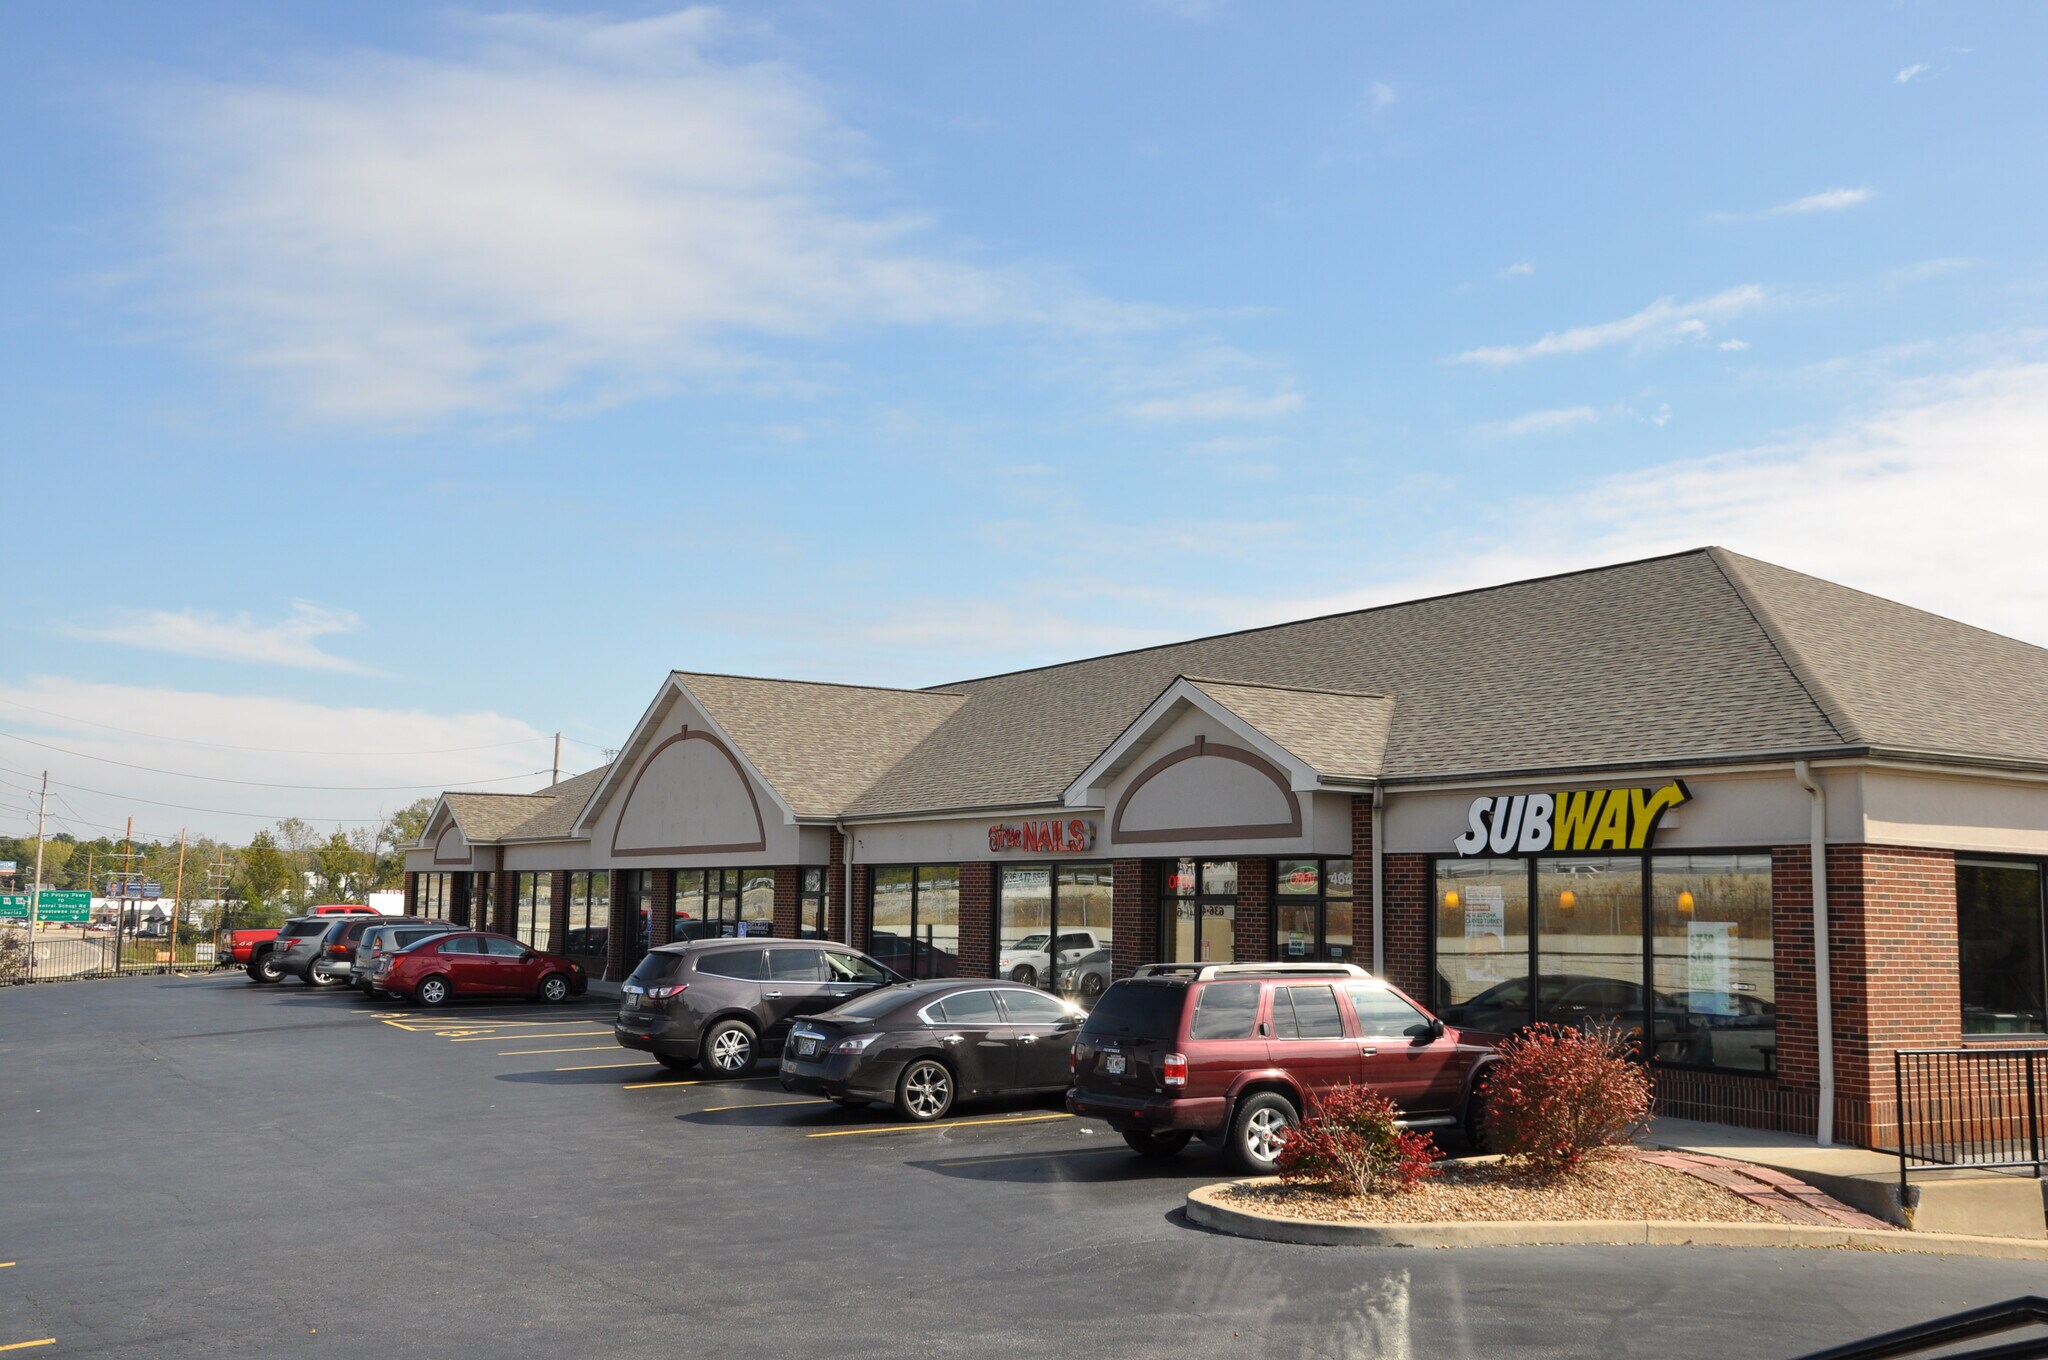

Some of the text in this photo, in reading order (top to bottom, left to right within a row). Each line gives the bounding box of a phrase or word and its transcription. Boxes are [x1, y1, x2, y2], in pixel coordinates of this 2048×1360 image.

[1453, 779, 1692, 857] SUBWAY
[1022, 819, 1085, 852] NAILS
[1290, 871, 1316, 885] OPEN
[1690, 952, 1714, 963] SUB
